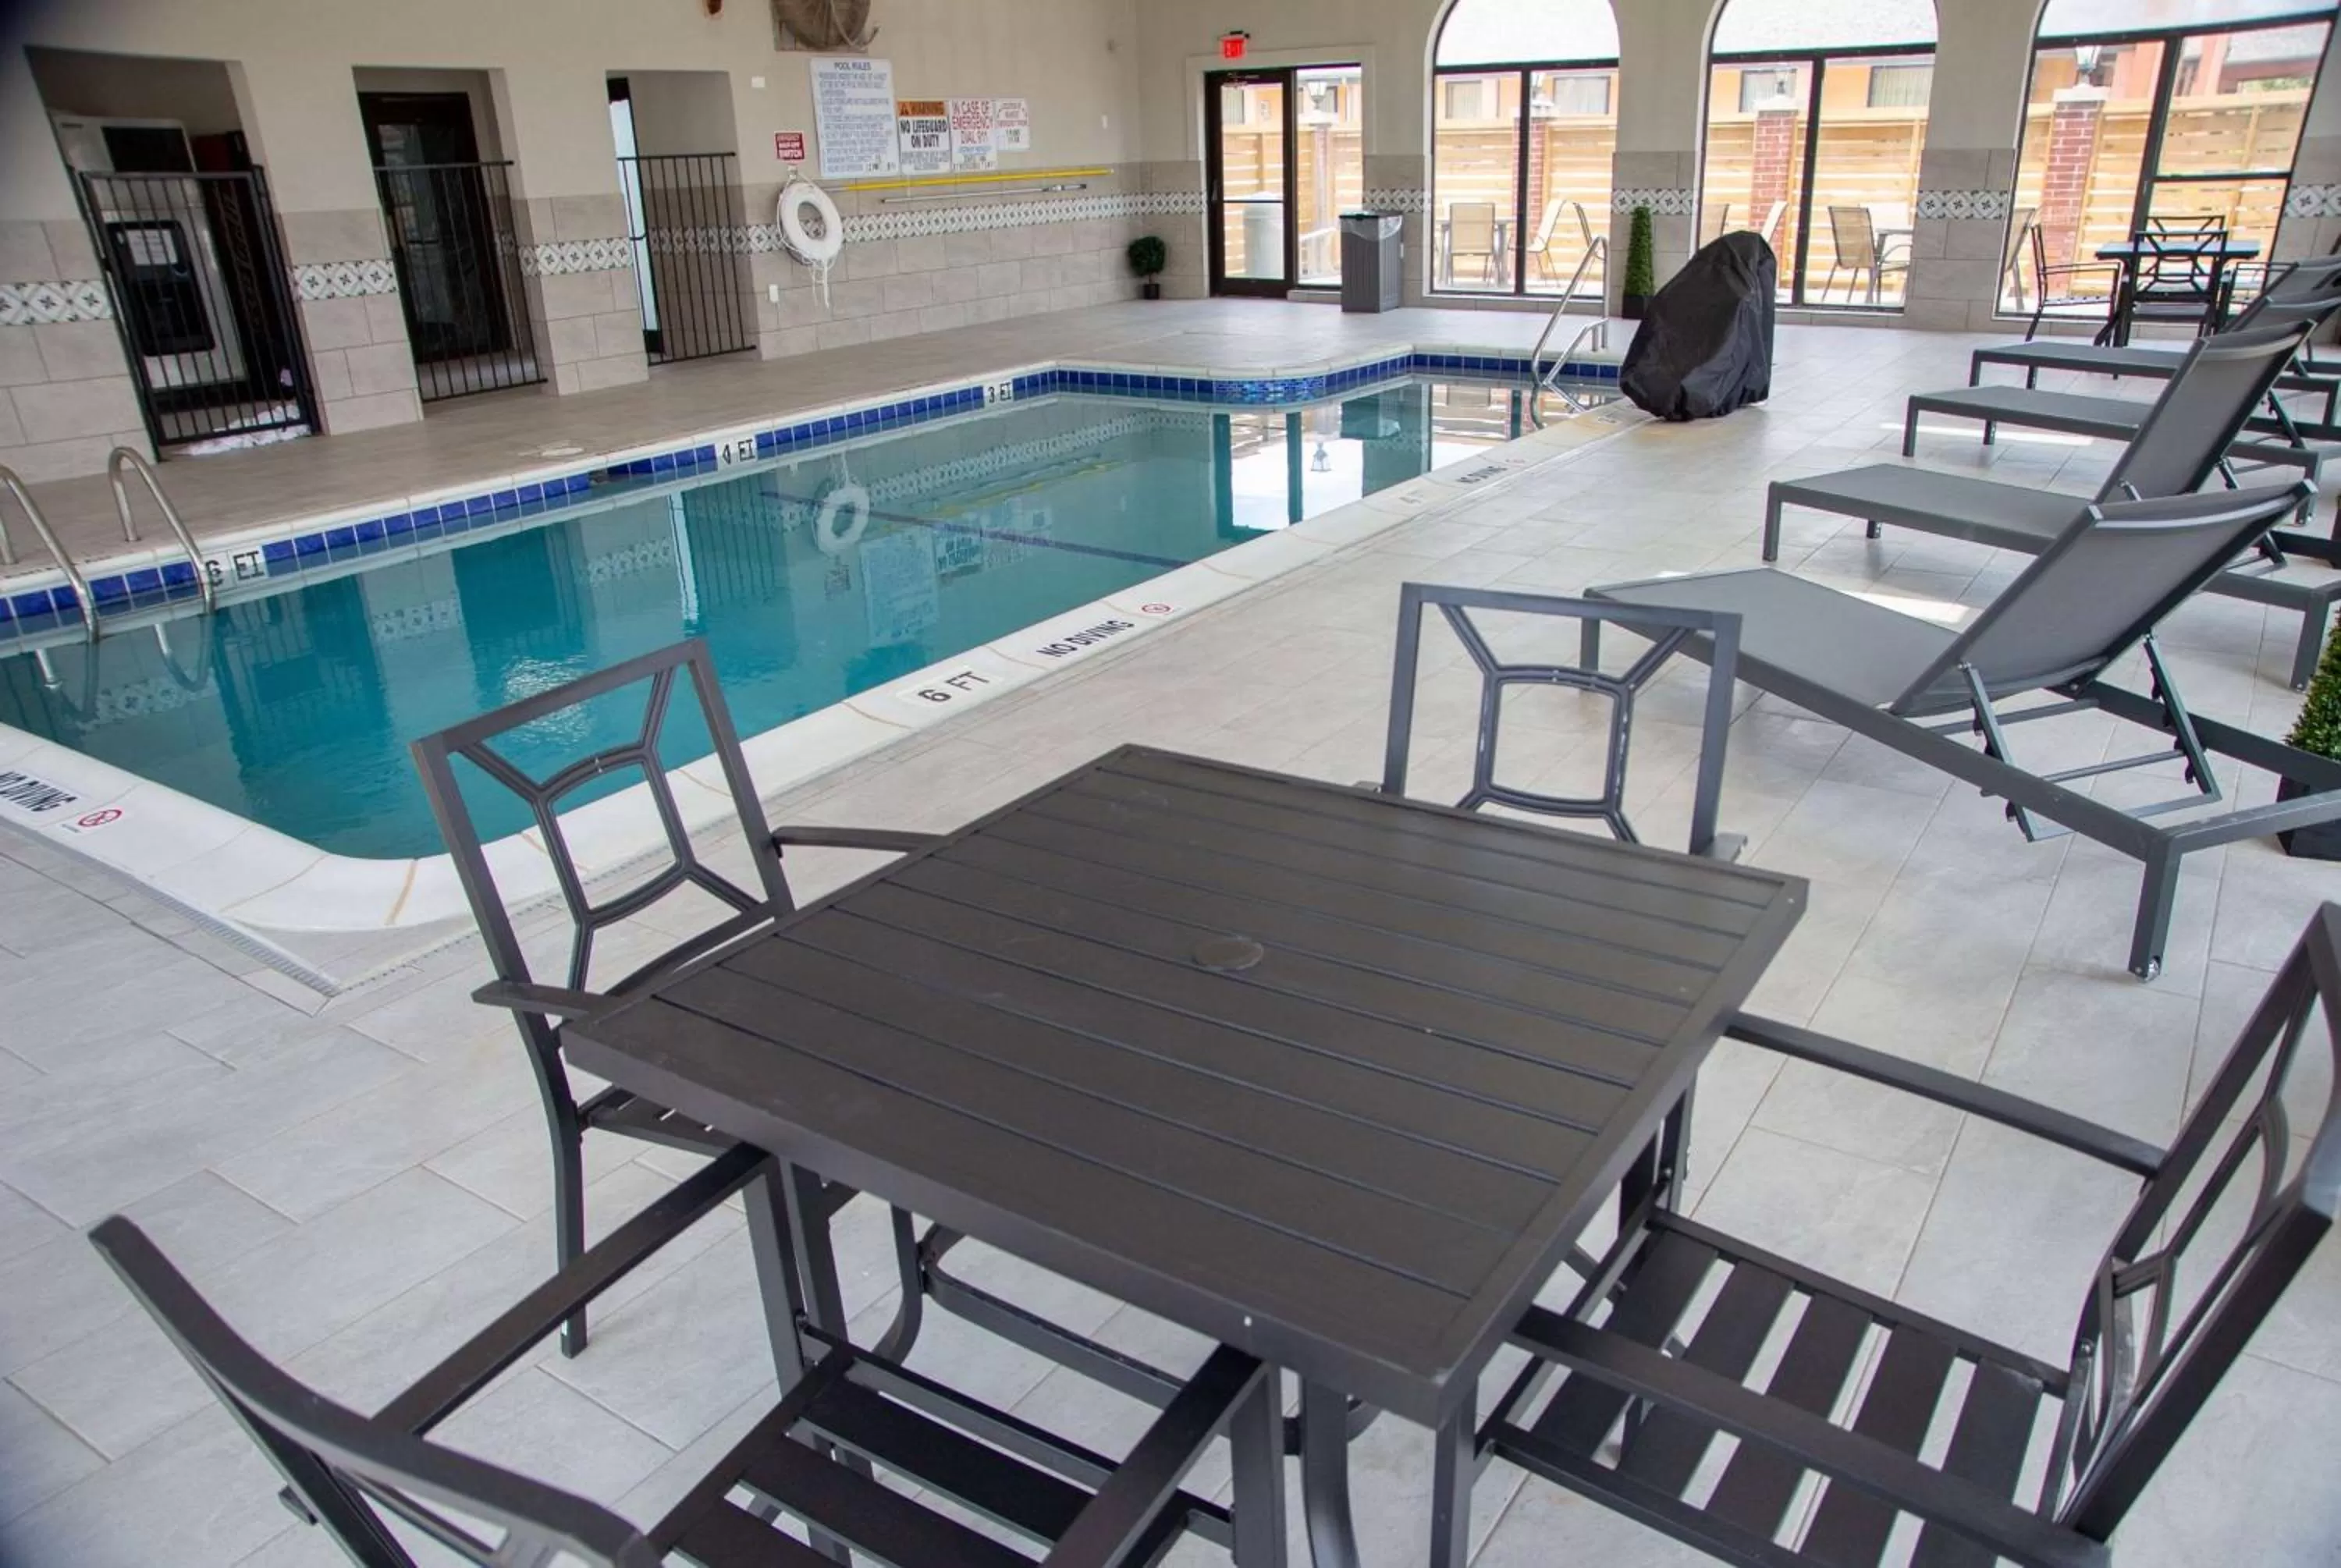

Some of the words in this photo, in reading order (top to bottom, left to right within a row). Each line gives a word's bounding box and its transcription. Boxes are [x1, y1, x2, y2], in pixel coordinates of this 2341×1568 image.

[833, 62, 851, 70] POOL
[961, 100, 980, 115] CASE
[982, 100, 989, 115] OF
[900, 119, 911, 133] NO
[912, 119, 947, 133] LIFEGUARD
[953, 115, 993, 130] EMERGENCY
[911, 135, 922, 148] ON
[923, 133, 940, 147] DUTY
[961, 129, 976, 144] DIAL
[1036, 644, 1078, 657] NO
[1064, 620, 1135, 646] DIVING
[918, 689, 952, 702] 6
[945, 671, 990, 691] FT
